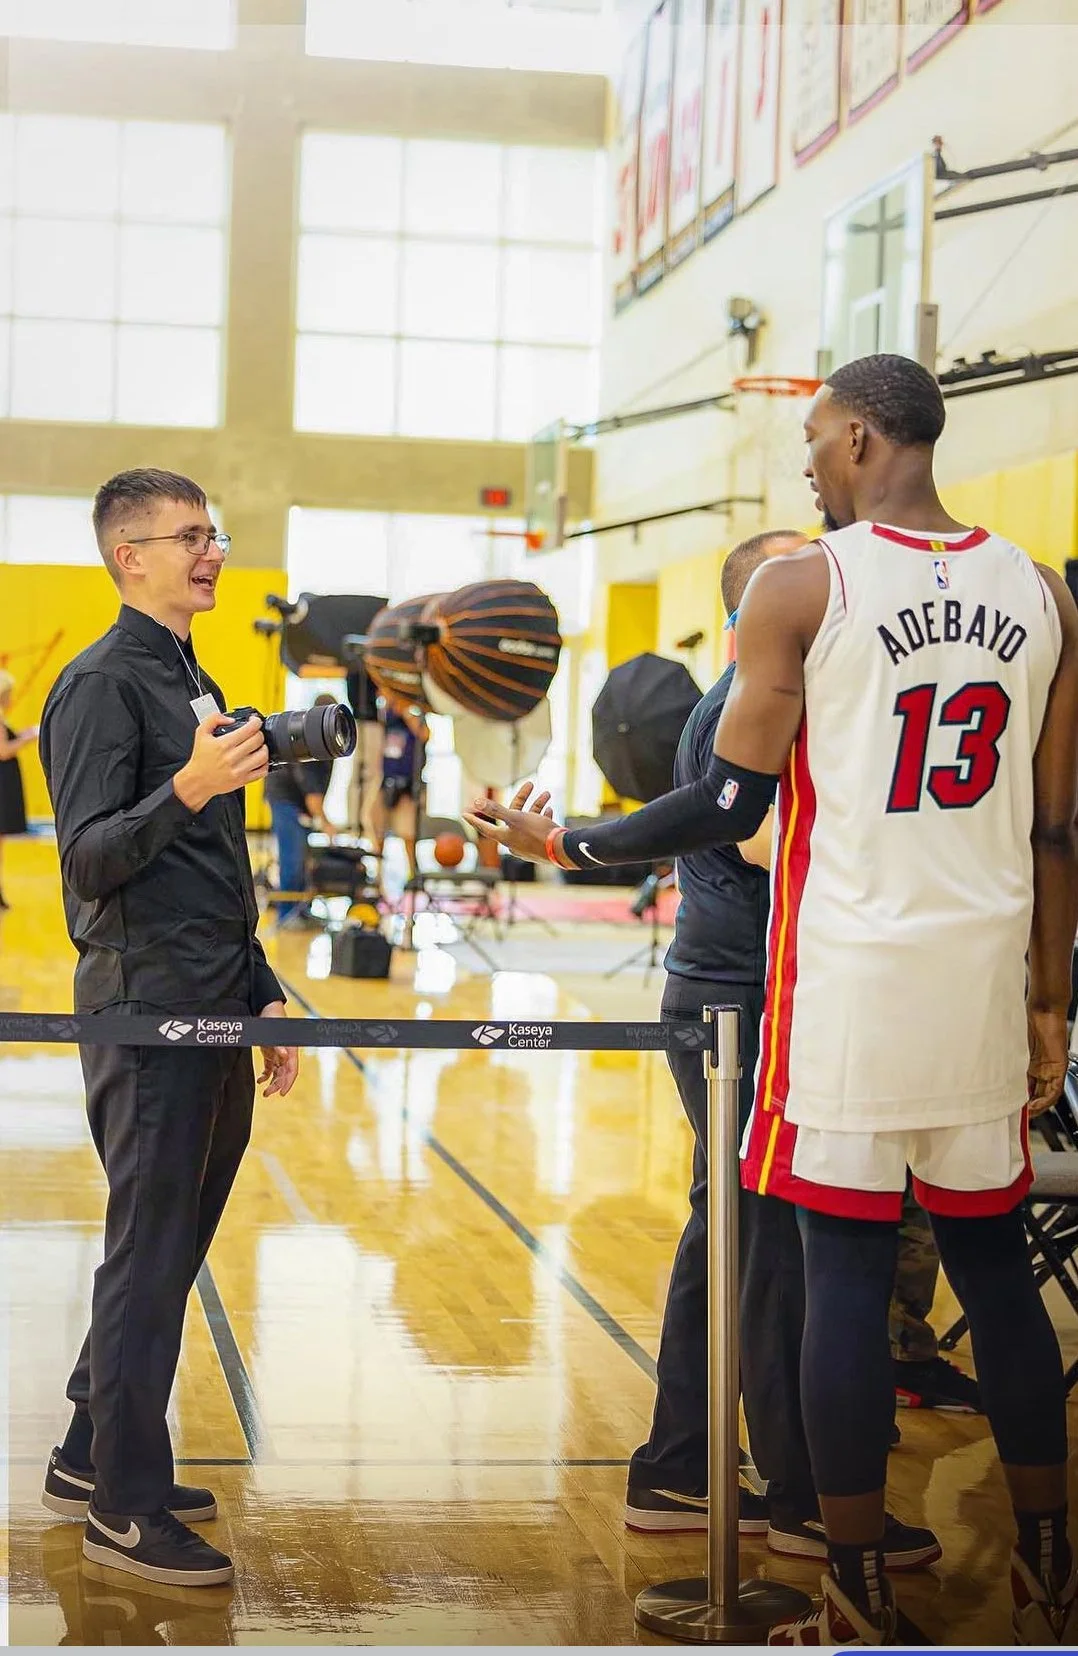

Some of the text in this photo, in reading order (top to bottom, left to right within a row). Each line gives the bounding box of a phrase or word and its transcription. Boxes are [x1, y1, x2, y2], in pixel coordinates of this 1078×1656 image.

[877, 600, 1027, 666] ADEBAYO
[885, 681, 1011, 813] 13
[197, 1018, 243, 1033] Kaseya
[508, 1023, 553, 1037] Kaseya
[196, 1031, 241, 1044] Center
[507, 1035, 551, 1048] Center
